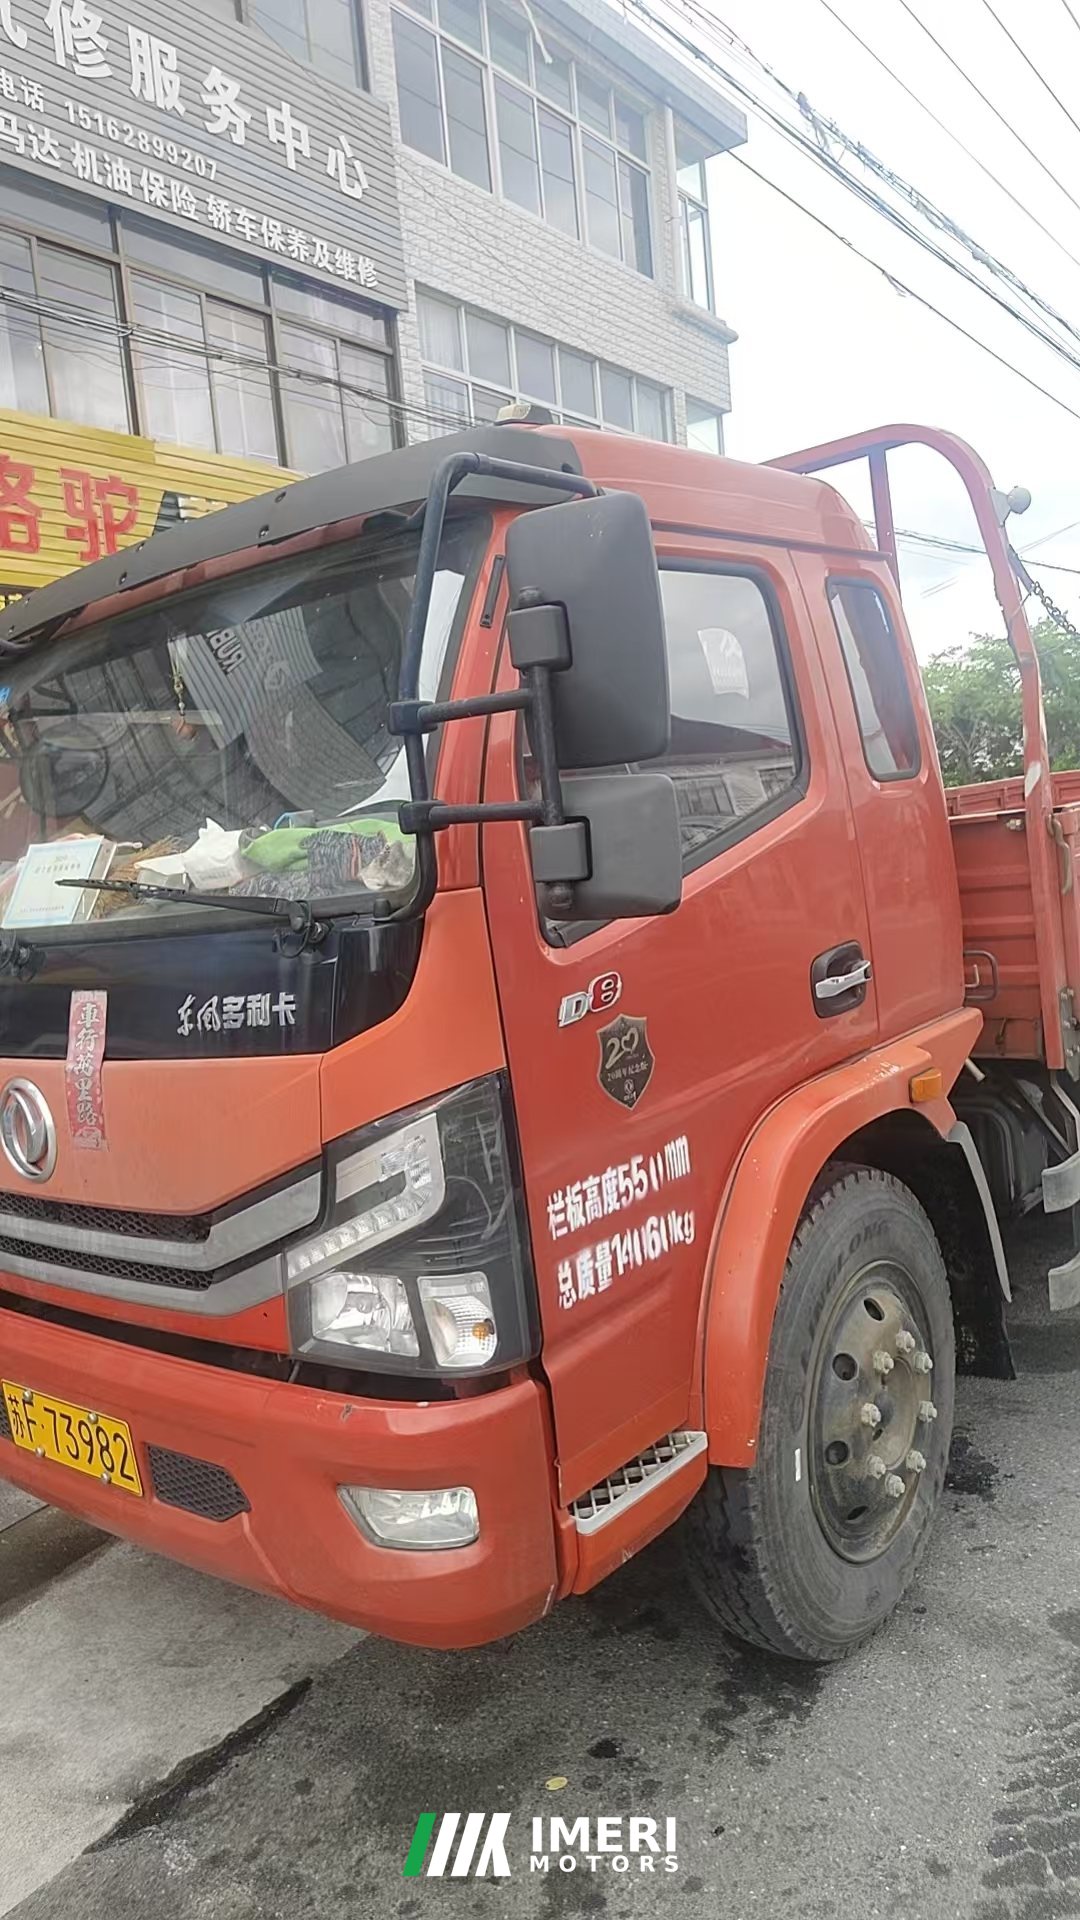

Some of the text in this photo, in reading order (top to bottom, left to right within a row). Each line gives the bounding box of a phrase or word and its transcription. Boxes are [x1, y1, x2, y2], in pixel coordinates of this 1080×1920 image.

[0, 67, 217, 181] 电话 15162899207
[0, 111, 378, 288] 马达 机油 保险 轿车保养及维修
[177, 991, 297, 1036] 东风多利卡
[558, 971, 622, 1028] D8
